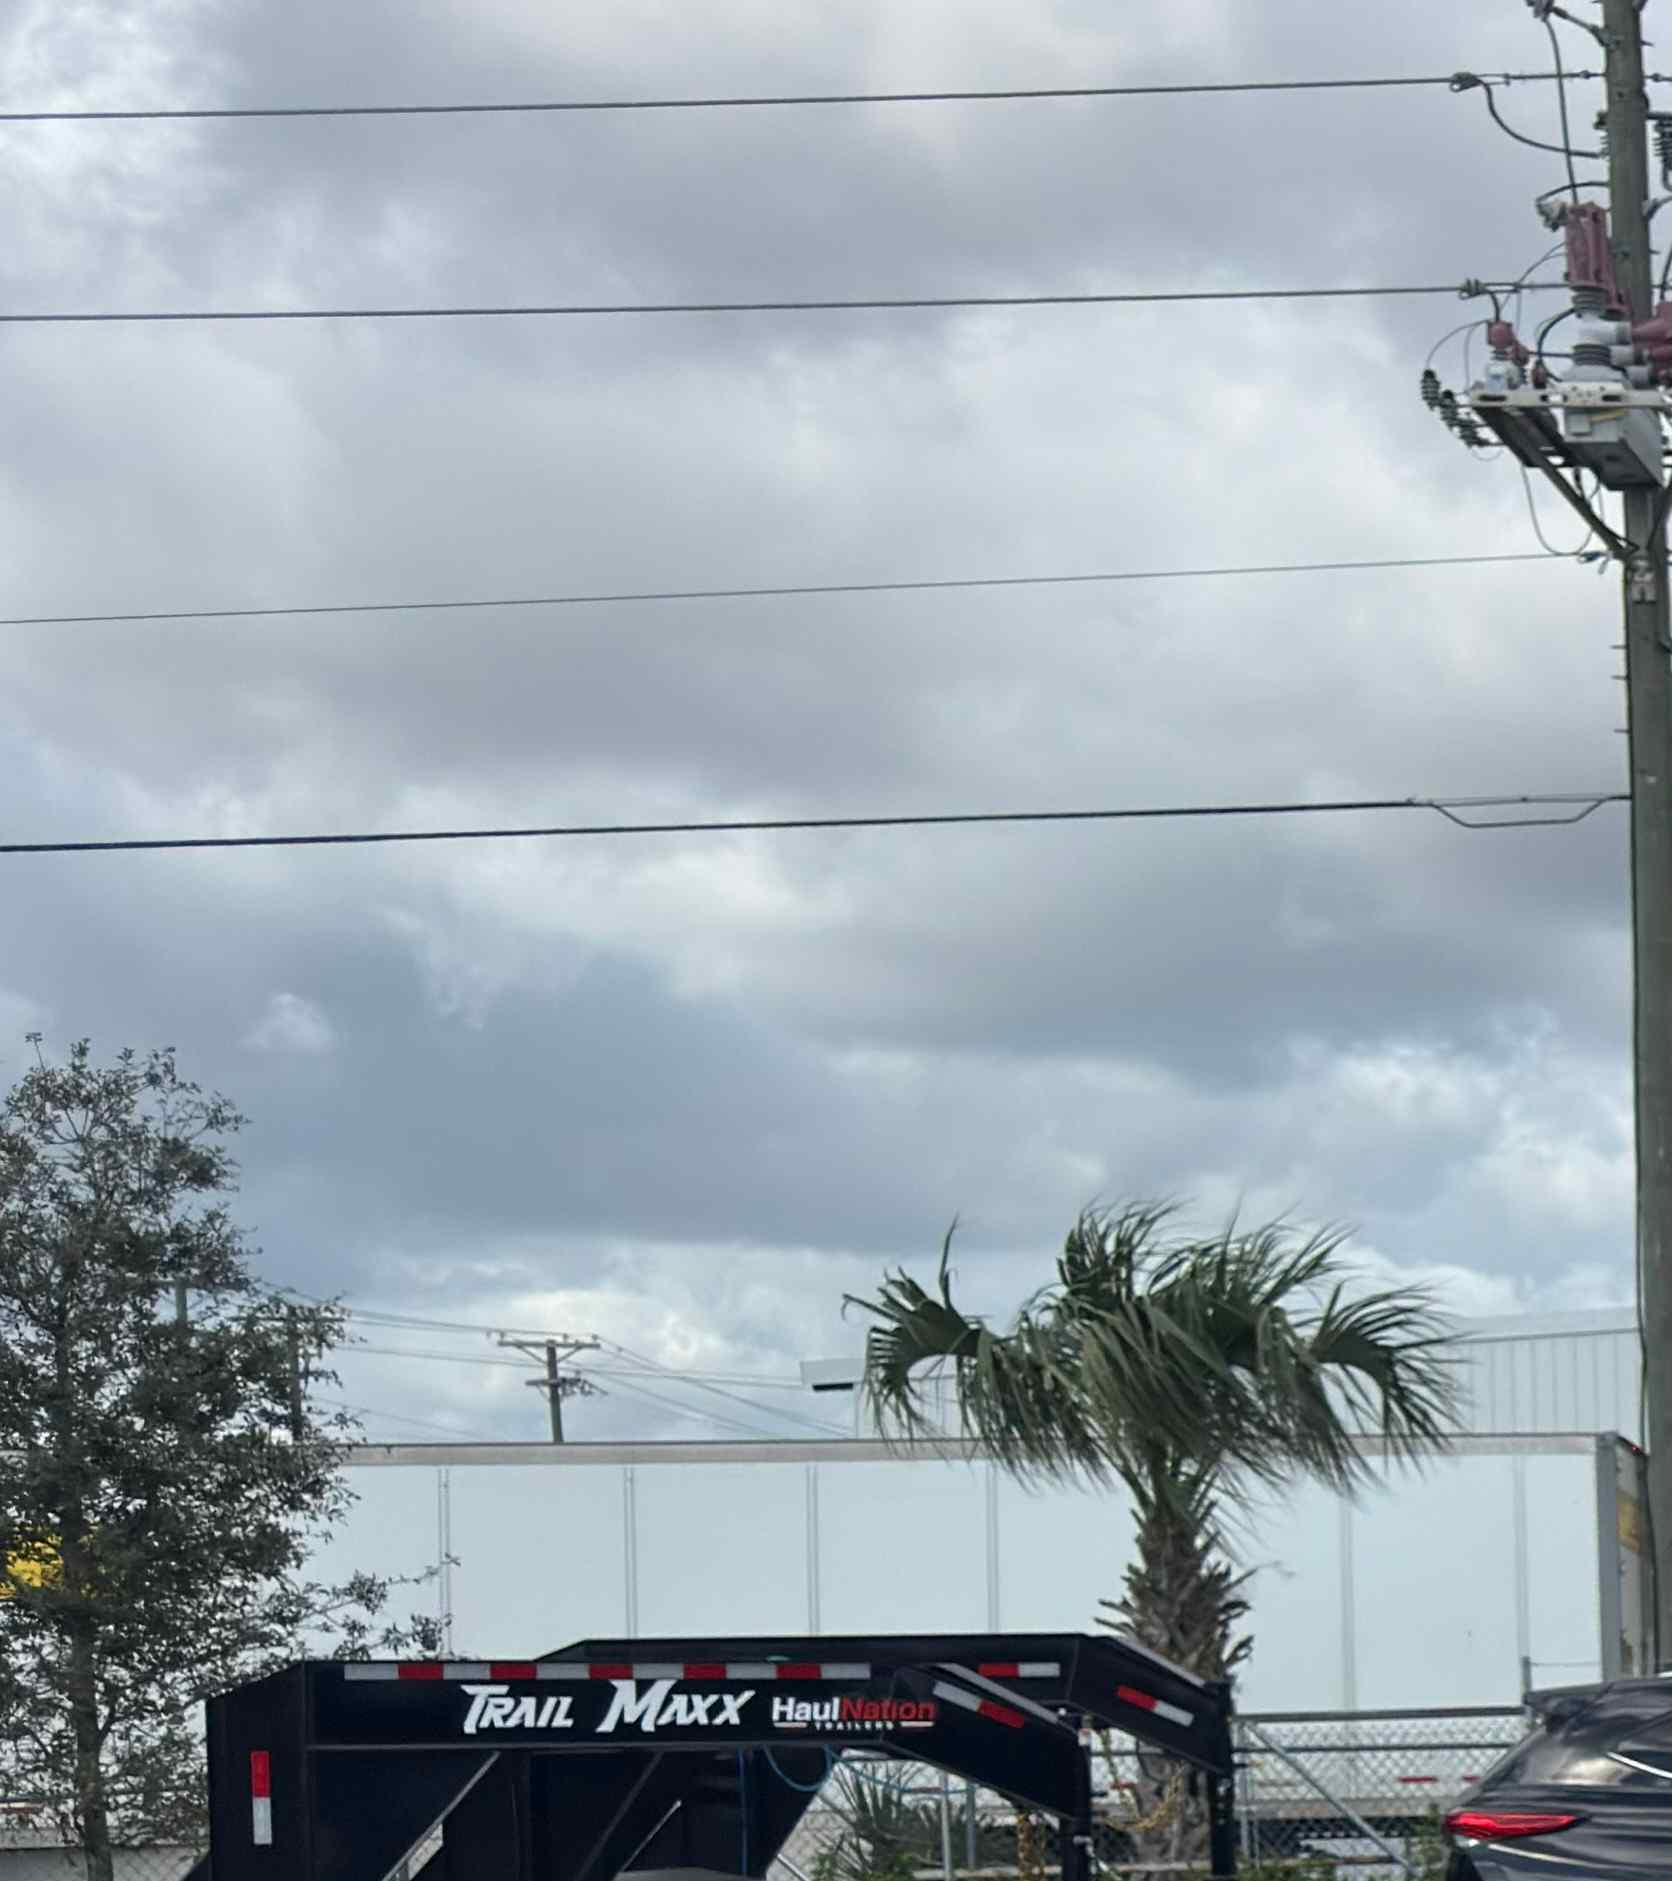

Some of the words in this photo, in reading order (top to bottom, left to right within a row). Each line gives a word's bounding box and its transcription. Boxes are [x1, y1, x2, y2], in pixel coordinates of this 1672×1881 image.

[460, 1684, 574, 1734] TRAIL
[595, 1679, 756, 1733] MAXX
[772, 1697, 937, 1721] HaulNation
[815, 1721, 894, 1731] TRAILERS
